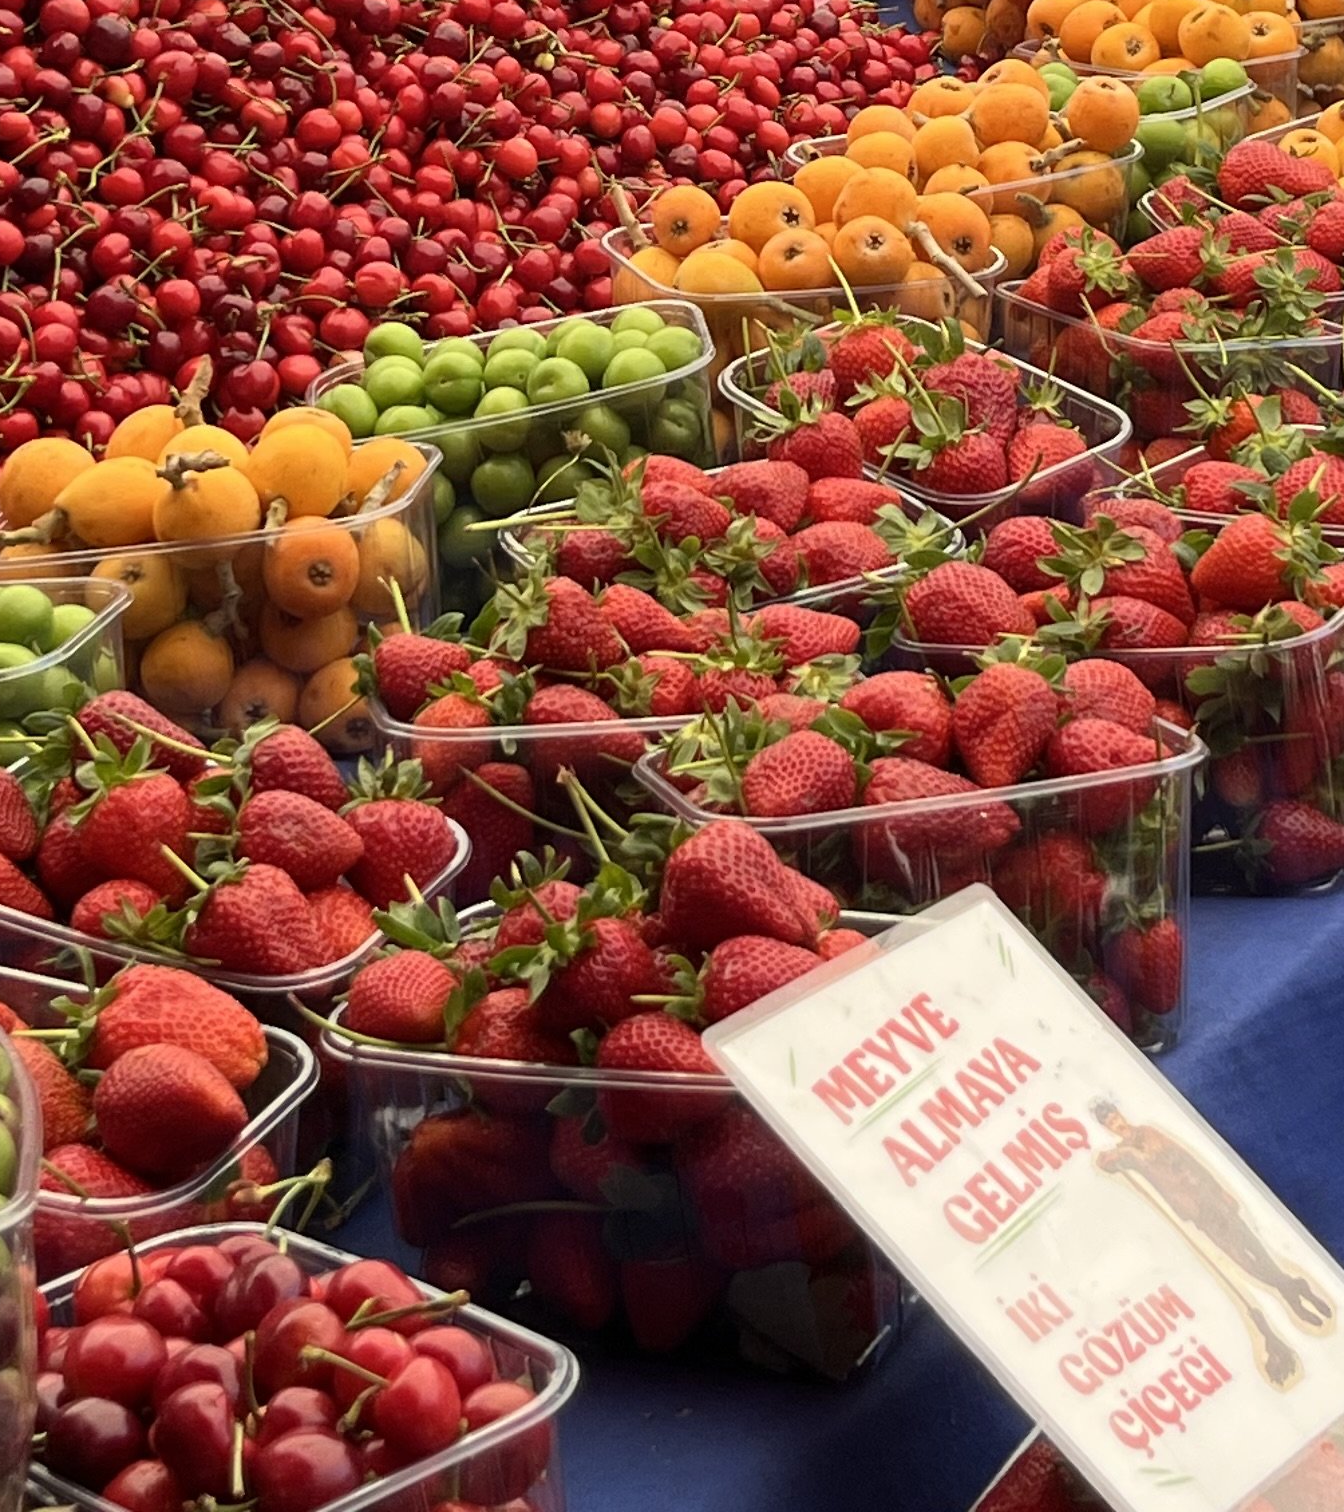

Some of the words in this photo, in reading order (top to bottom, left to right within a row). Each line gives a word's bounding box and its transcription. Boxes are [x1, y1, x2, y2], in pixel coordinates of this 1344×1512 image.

[811, 991, 960, 1126] MEYVE
[881, 1036, 1042, 1188] ALMAYA
[942, 1102, 1091, 1245] GELMİŞ
[996, 1273, 1074, 1343] İKİ
[1058, 1283, 1196, 1396] GÖZÜM
[1108, 1336, 1233, 1460] ÇİÇEĞİ
